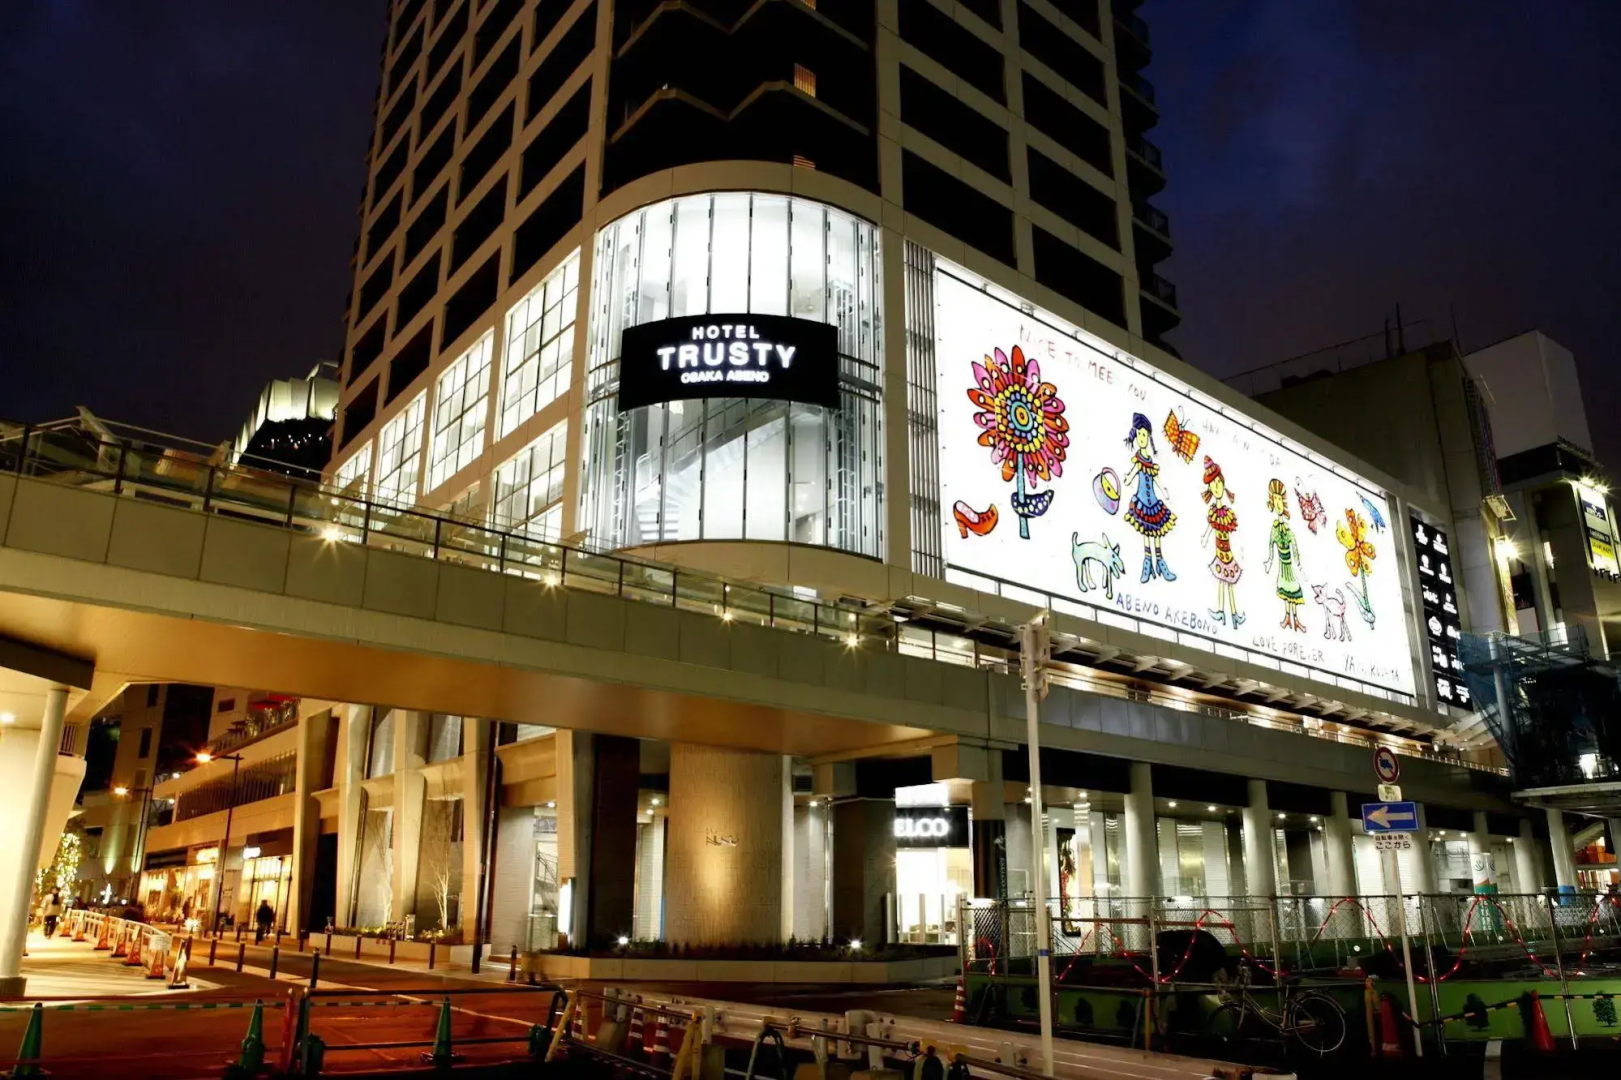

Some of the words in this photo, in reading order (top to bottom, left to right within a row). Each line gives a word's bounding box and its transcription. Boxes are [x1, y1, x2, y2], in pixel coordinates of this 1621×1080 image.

[692, 325, 760, 340] HOTEL
[656, 341, 796, 371] TRUSTY
[1019, 323, 1056, 360] NE
[1087, 359, 1115, 385] MEE
[680, 370, 723, 384] OSAKA
[1116, 591, 1160, 616] ABENO
[1164, 606, 1218, 635] AKEBONO
[1251, 634, 1278, 653] LOVE
[1282, 641, 1325, 663] FOREER
[1375, 841, 1411, 850] ここから
